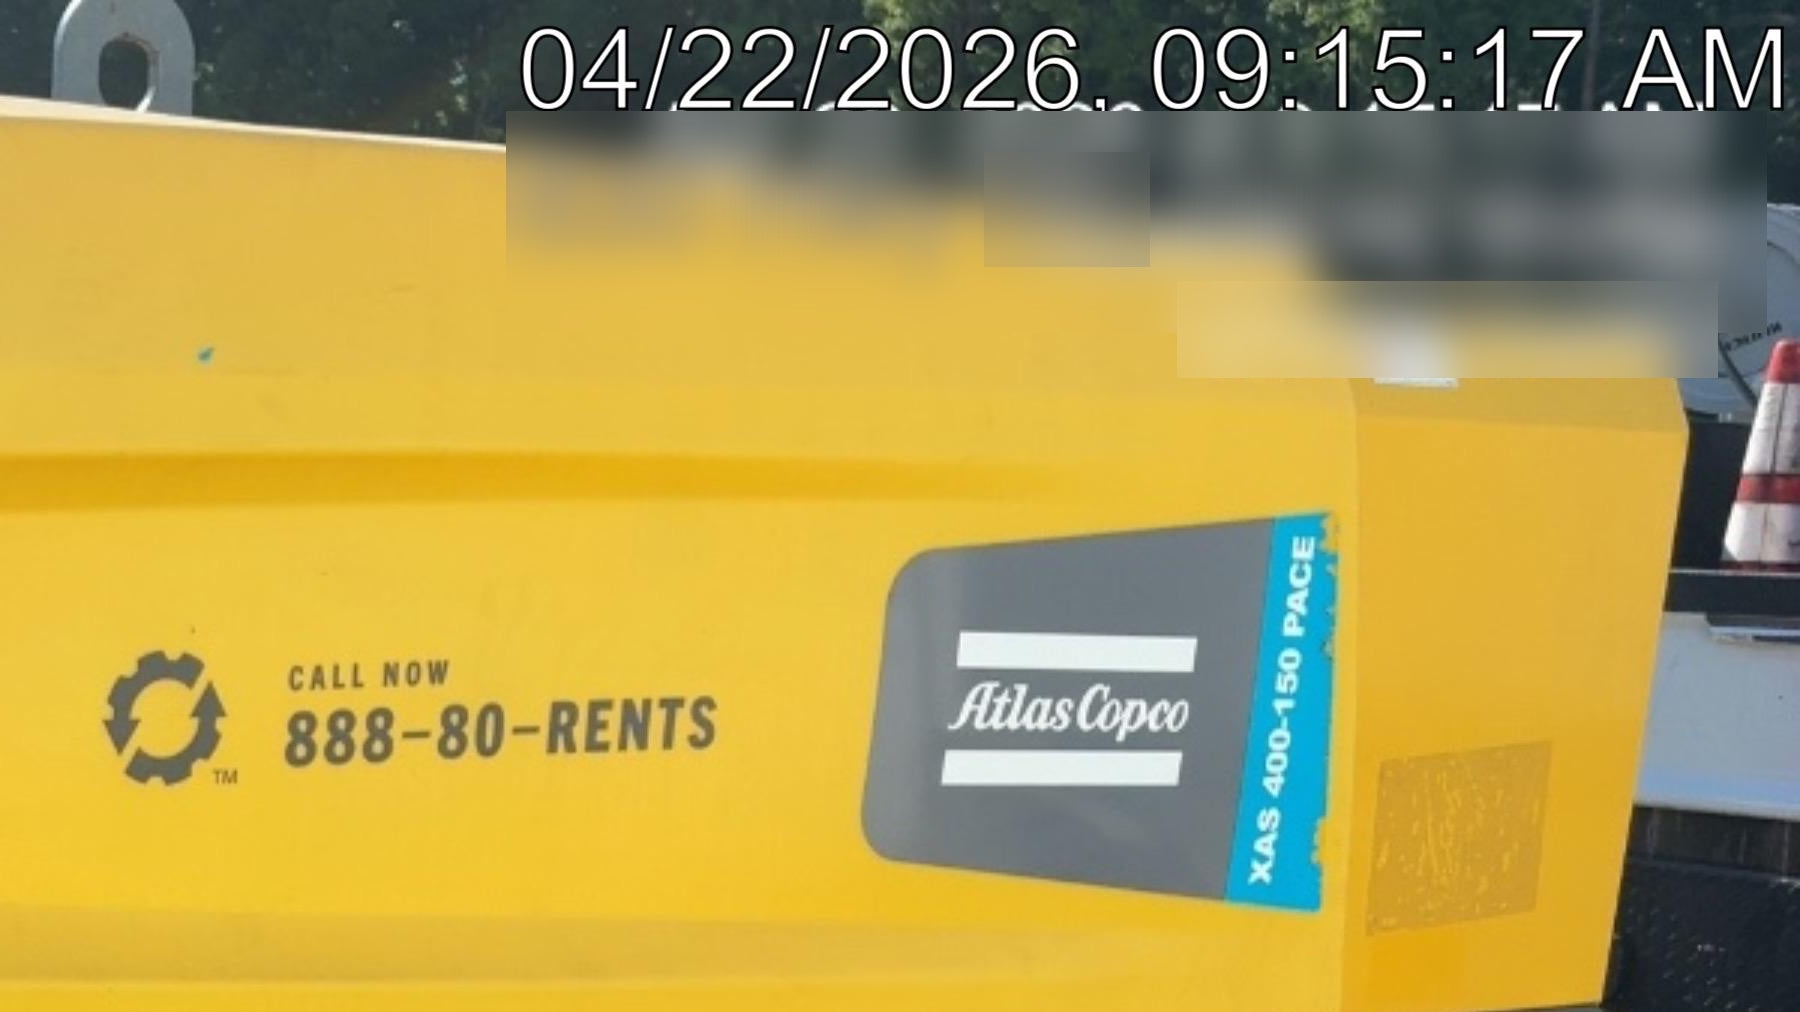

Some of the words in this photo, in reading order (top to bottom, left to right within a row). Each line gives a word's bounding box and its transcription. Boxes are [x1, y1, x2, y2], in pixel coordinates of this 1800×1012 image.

[1282, 535, 1316, 637] PACE
[287, 662, 367, 691] CALL
[382, 659, 451, 687] NOW
[948, 680, 1073, 731] Atlas
[1076, 683, 1190, 742] Copco
[284, 695, 719, 769] 888-80-RENTS
[1264, 648, 1303, 799] 400-150
[1248, 807, 1282, 886] XAS
